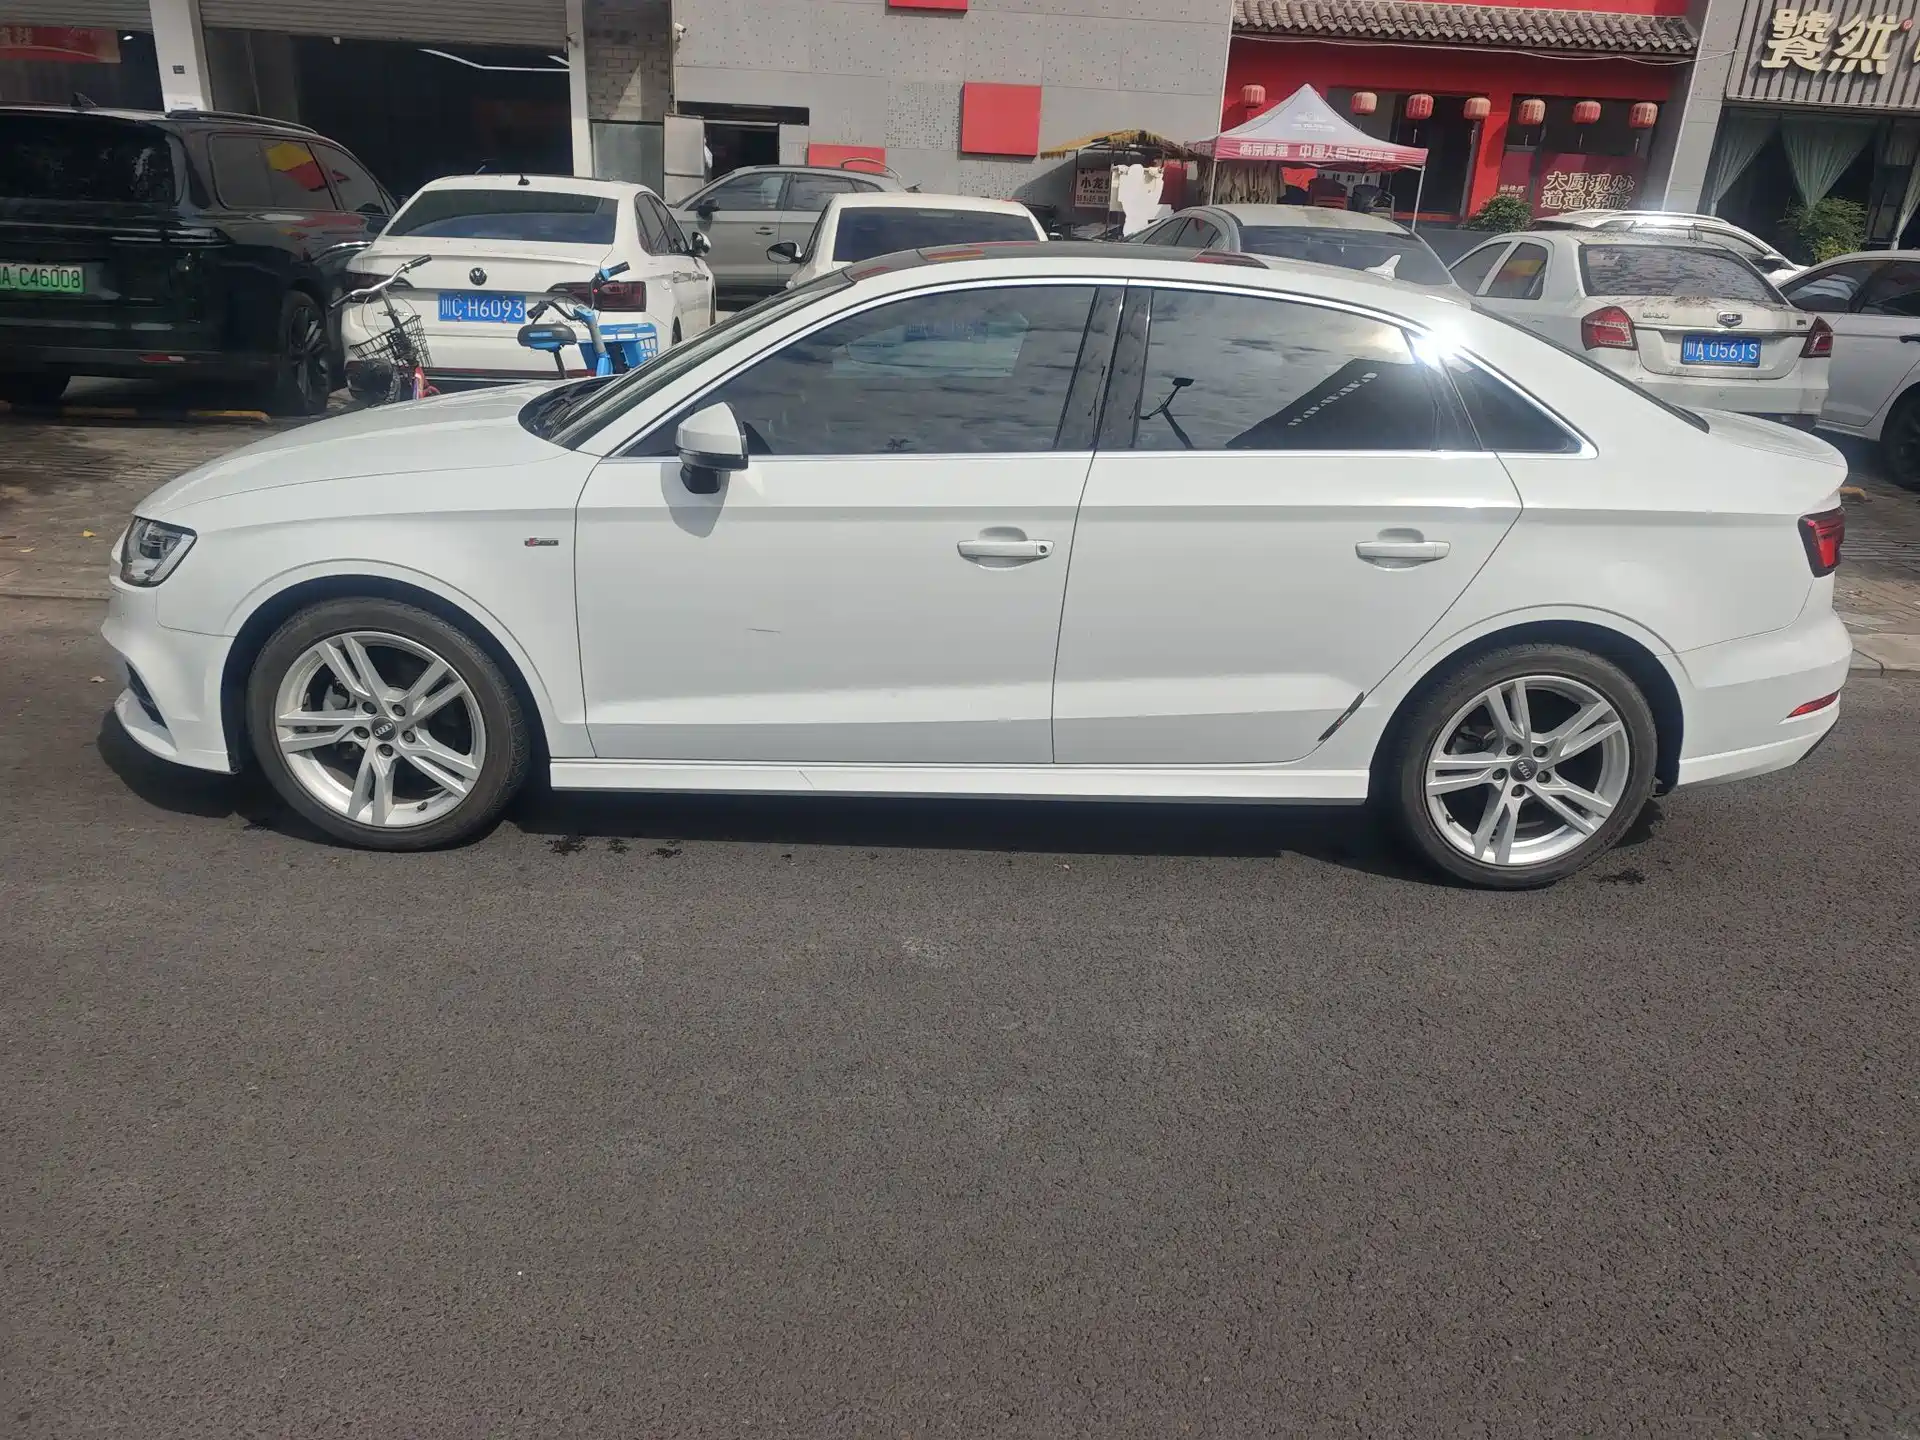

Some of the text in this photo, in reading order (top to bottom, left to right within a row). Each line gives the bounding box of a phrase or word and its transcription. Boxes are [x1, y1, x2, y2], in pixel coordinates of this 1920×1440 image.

[1761, 9, 1920, 75] 饕然
[1544, 171, 1636, 194] 大厨现炒
[1541, 190, 1632, 210] 道道好吃
